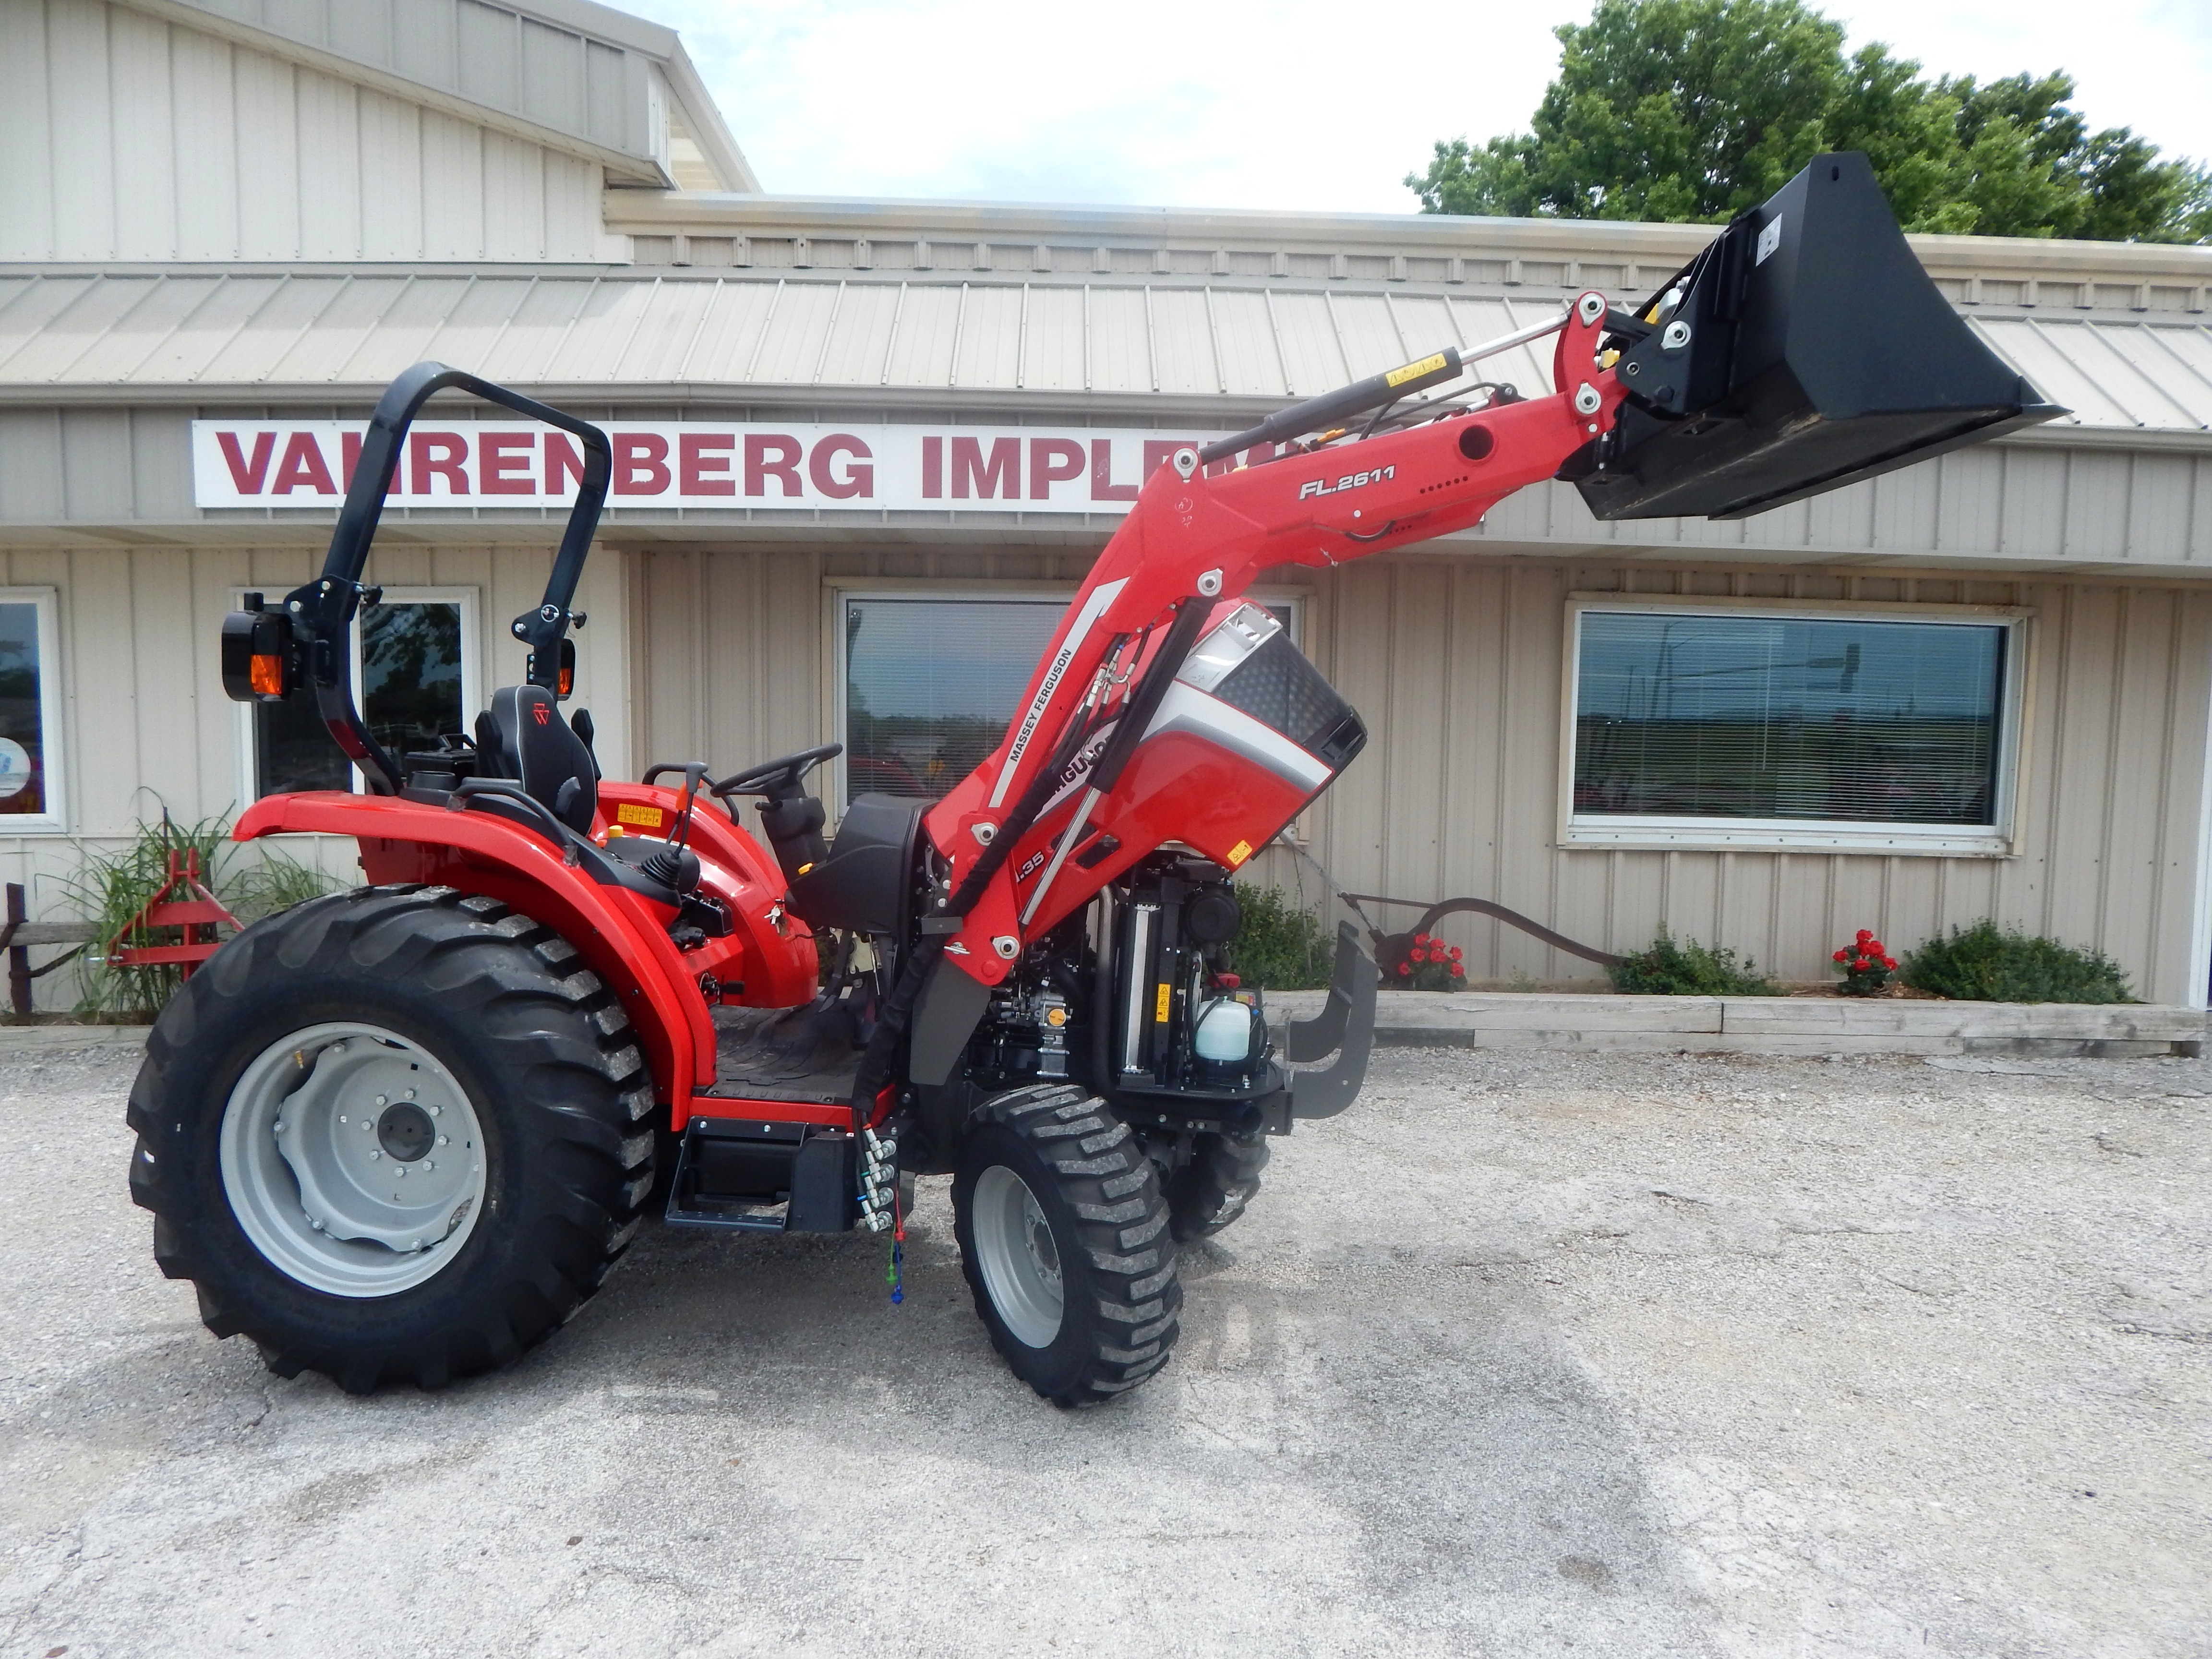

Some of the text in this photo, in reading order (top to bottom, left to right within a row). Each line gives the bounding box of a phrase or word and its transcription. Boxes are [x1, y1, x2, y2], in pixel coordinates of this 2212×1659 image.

[1299, 465, 1395, 500] FL.2611
[1010, 649, 1071, 762] MASSEY FERGUSON
